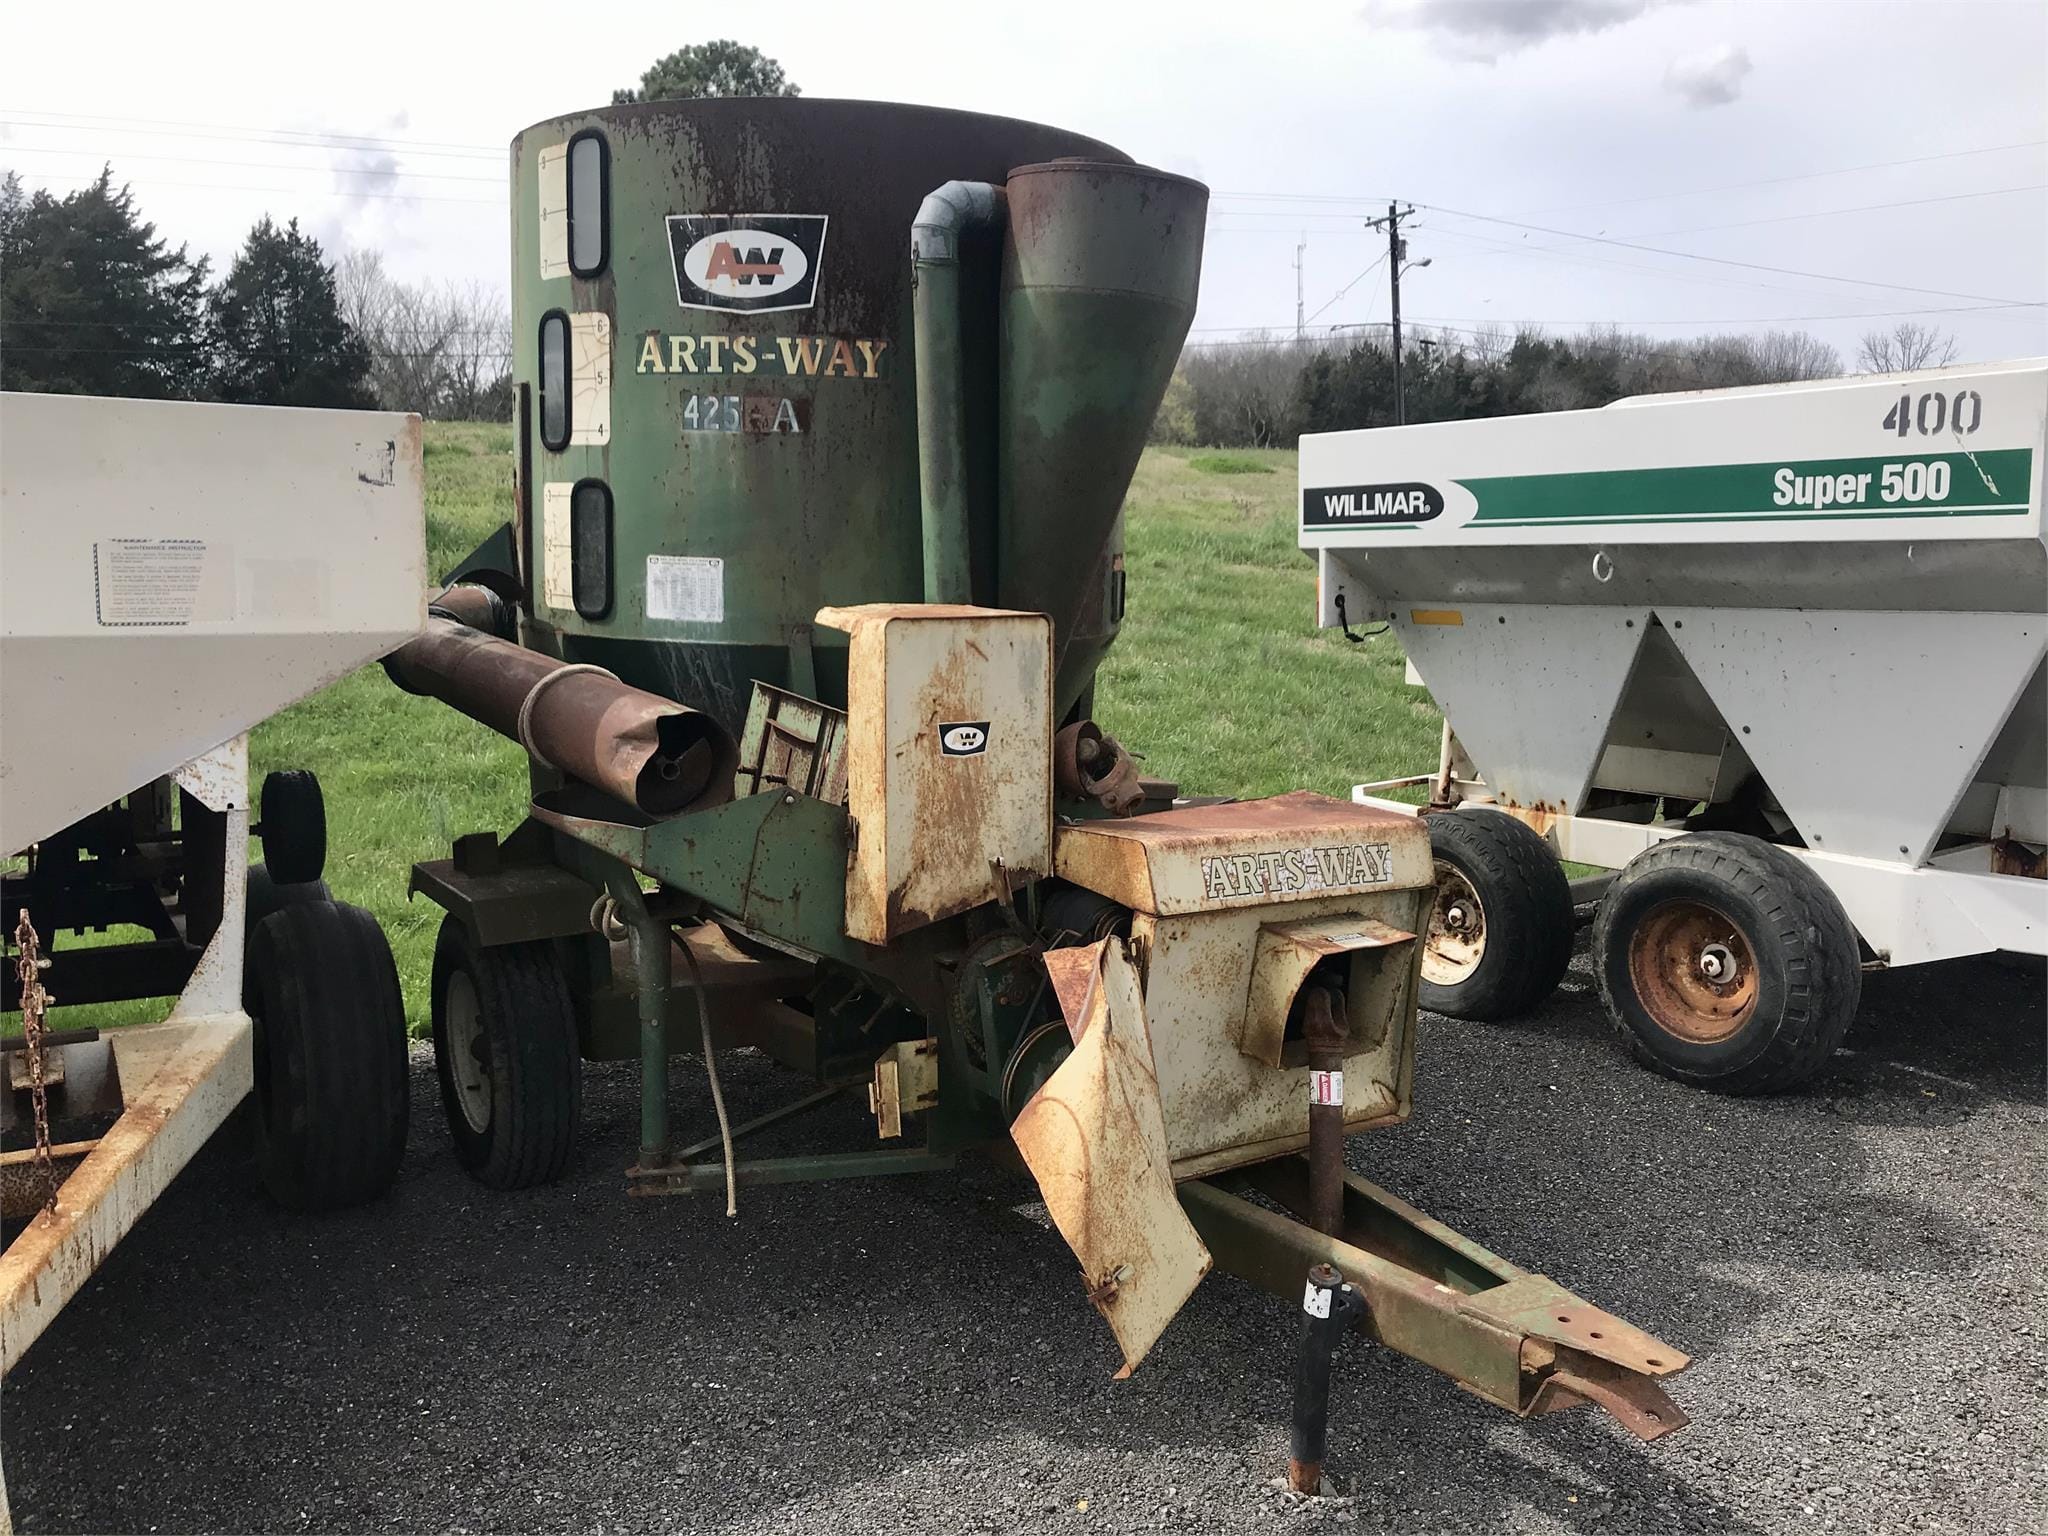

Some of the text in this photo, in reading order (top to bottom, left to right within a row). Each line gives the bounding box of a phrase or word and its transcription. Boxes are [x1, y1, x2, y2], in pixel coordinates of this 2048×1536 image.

[597, 320, 603, 332] 6
[636, 335, 887, 379] ARTS-WAY
[597, 371, 603, 384] 5
[597, 424, 604, 437] 4
[1883, 390, 1982, 437] 400
[1773, 461, 1951, 509] Super 500
[1324, 491, 1431, 518] WILLMAR
[1206, 843, 1390, 899] ARTS-WAY
